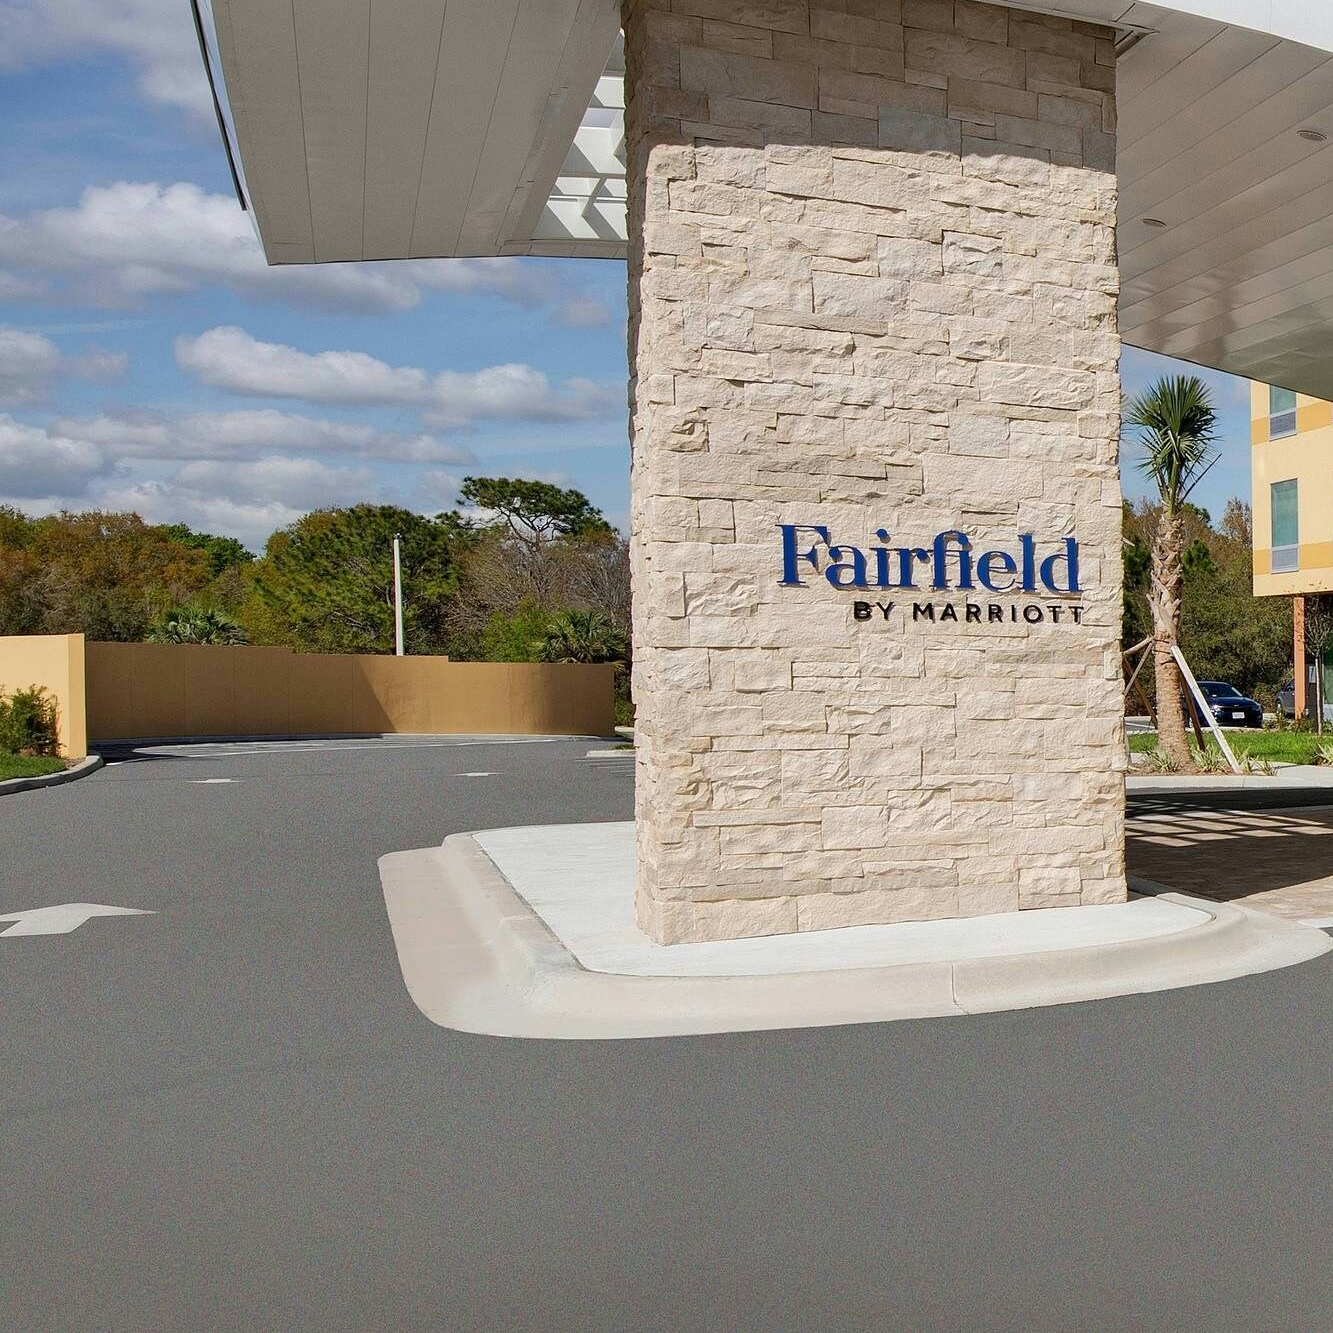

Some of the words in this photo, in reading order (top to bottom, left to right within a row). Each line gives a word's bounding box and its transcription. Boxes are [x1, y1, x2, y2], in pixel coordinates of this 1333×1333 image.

[775, 524, 1085, 592] Fairfield
[853, 601, 895, 622] BY
[911, 602, 1085, 624] MARRIOTT
